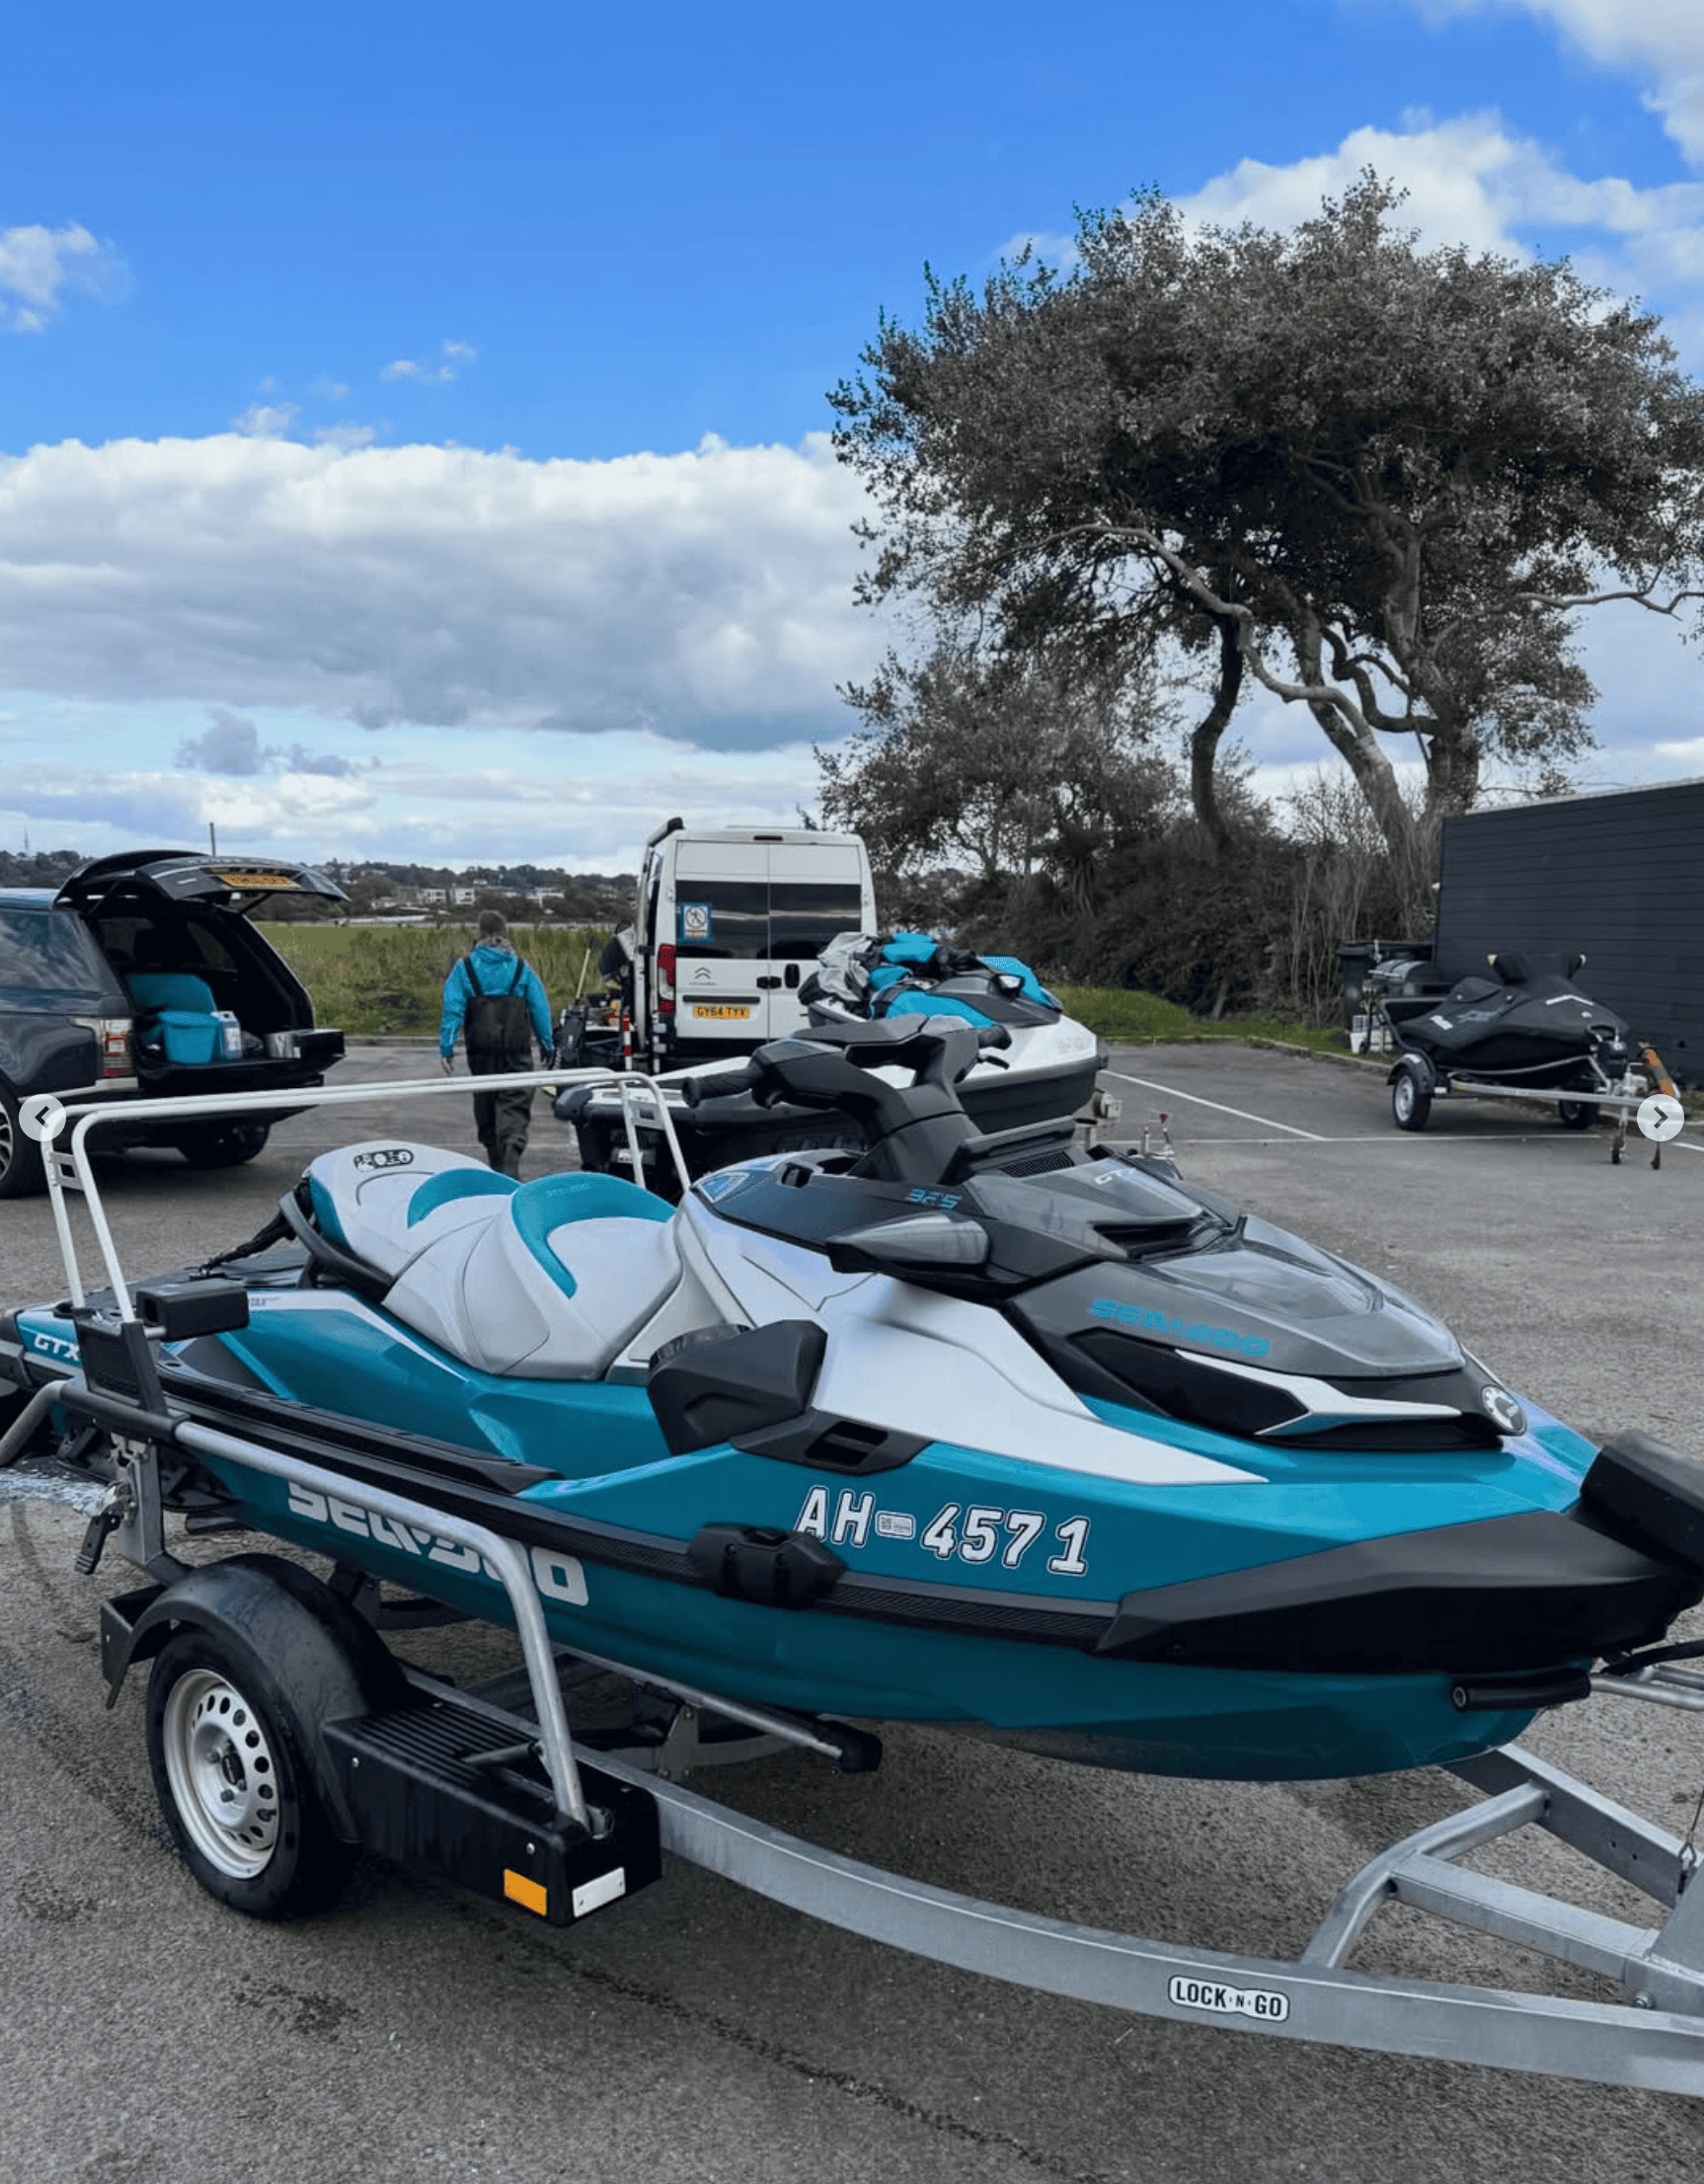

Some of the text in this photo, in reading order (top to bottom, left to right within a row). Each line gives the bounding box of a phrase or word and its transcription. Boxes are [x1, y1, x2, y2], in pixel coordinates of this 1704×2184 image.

[35, 1333, 80, 1361] GTX
[794, 1485, 1091, 1576] AH 4571
[1176, 1980, 1227, 2009] LOCK
[1254, 1993, 1282, 2017] GO
